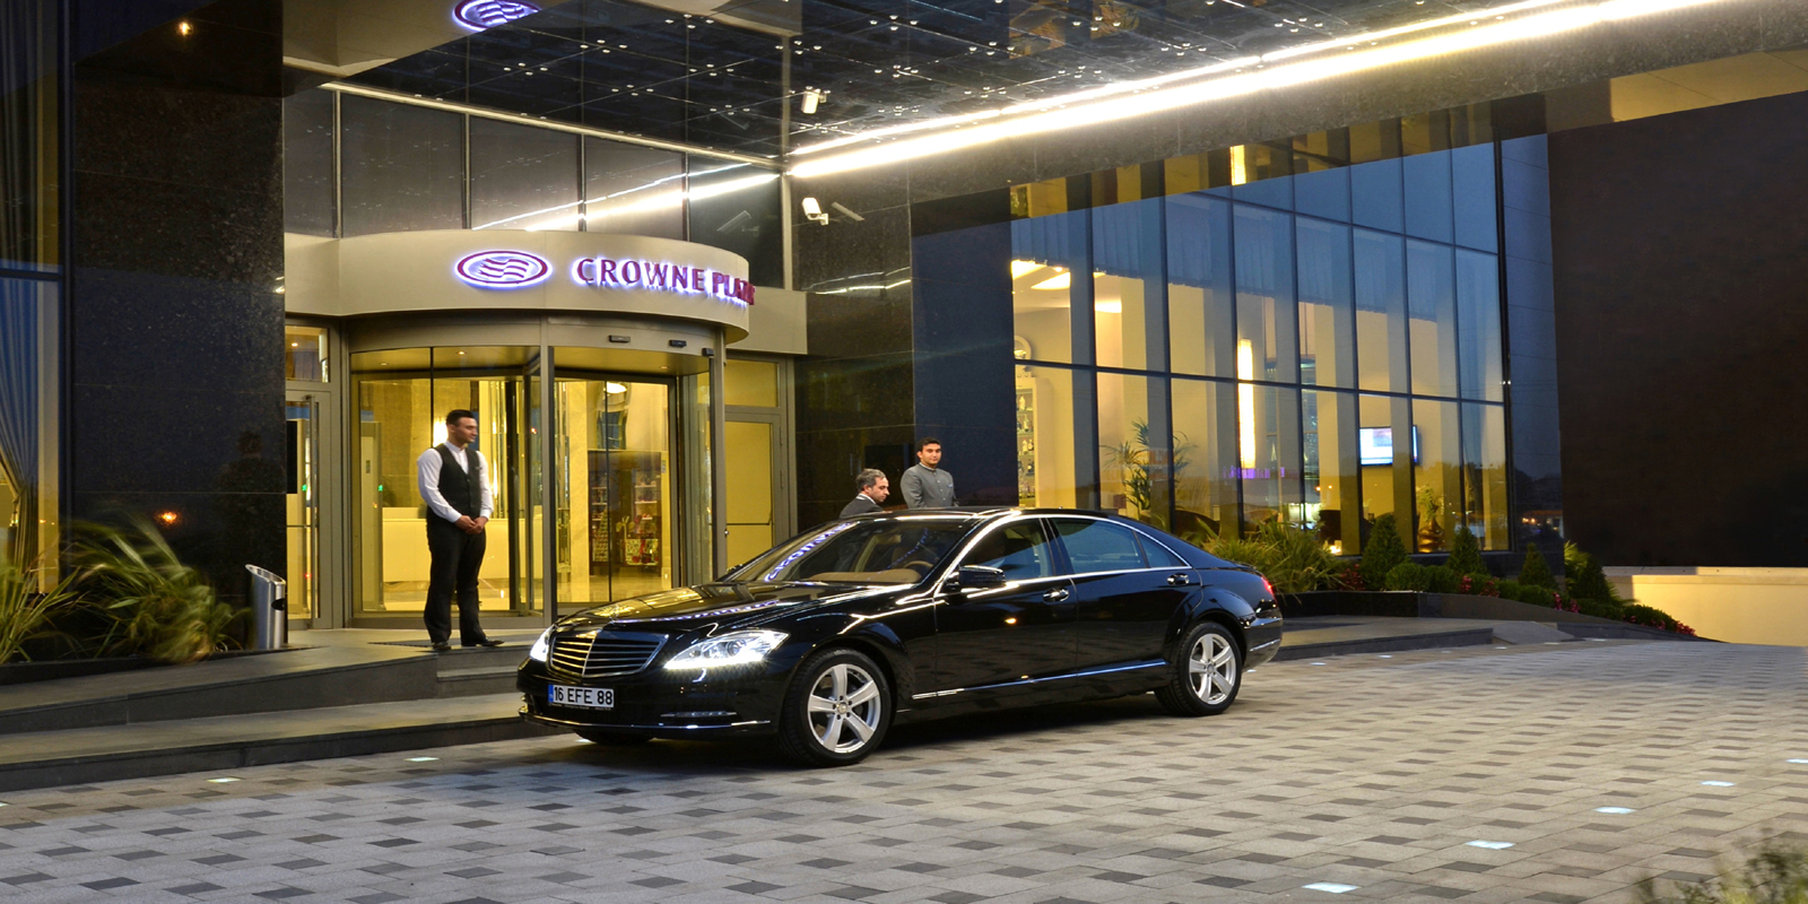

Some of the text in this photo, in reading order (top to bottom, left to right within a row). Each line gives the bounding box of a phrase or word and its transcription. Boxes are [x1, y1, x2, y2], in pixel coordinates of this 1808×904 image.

[576, 258, 705, 291] CROWNE
[554, 687, 613, 705] 16 EFE 88
